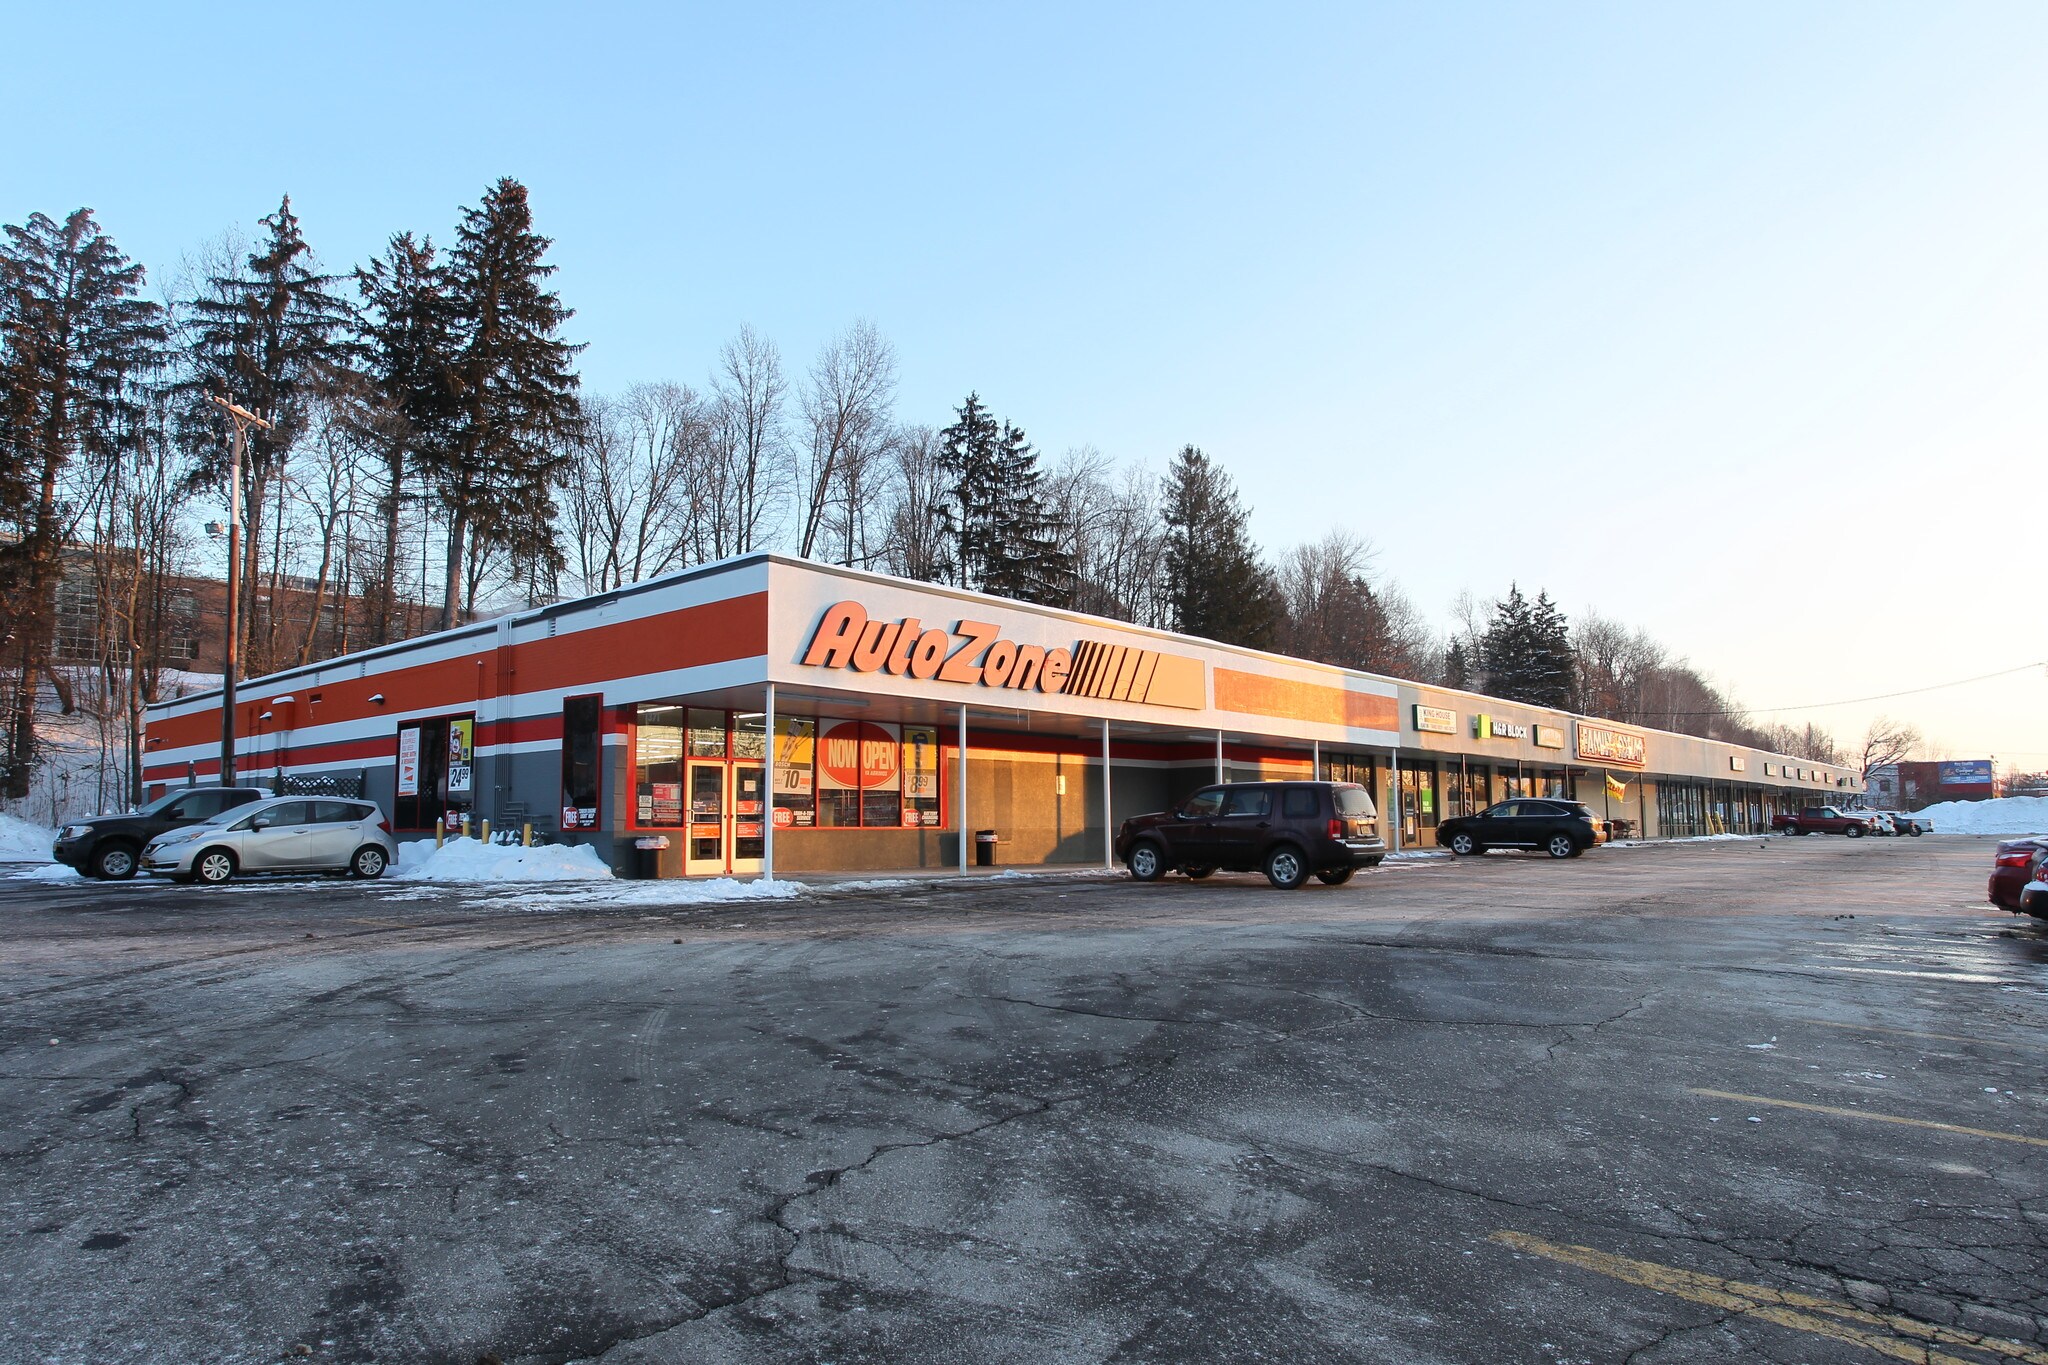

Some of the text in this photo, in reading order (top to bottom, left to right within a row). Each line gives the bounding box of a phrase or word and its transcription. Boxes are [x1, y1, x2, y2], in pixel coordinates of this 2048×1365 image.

[804, 600, 1073, 694] AutoZone
[1436, 711, 1451, 720] HOUSE
[1493, 721, 1507, 736] H&R
[1508, 724, 1528, 739] BLOCK
[1582, 728, 1611, 757] FAMILY
[828, 738, 895, 770] NOW OPEN
[448, 814, 458, 824] FREE
[565, 811, 577, 824] FREE
[774, 811, 791, 823] FREE
[905, 812, 919, 822] FREE
